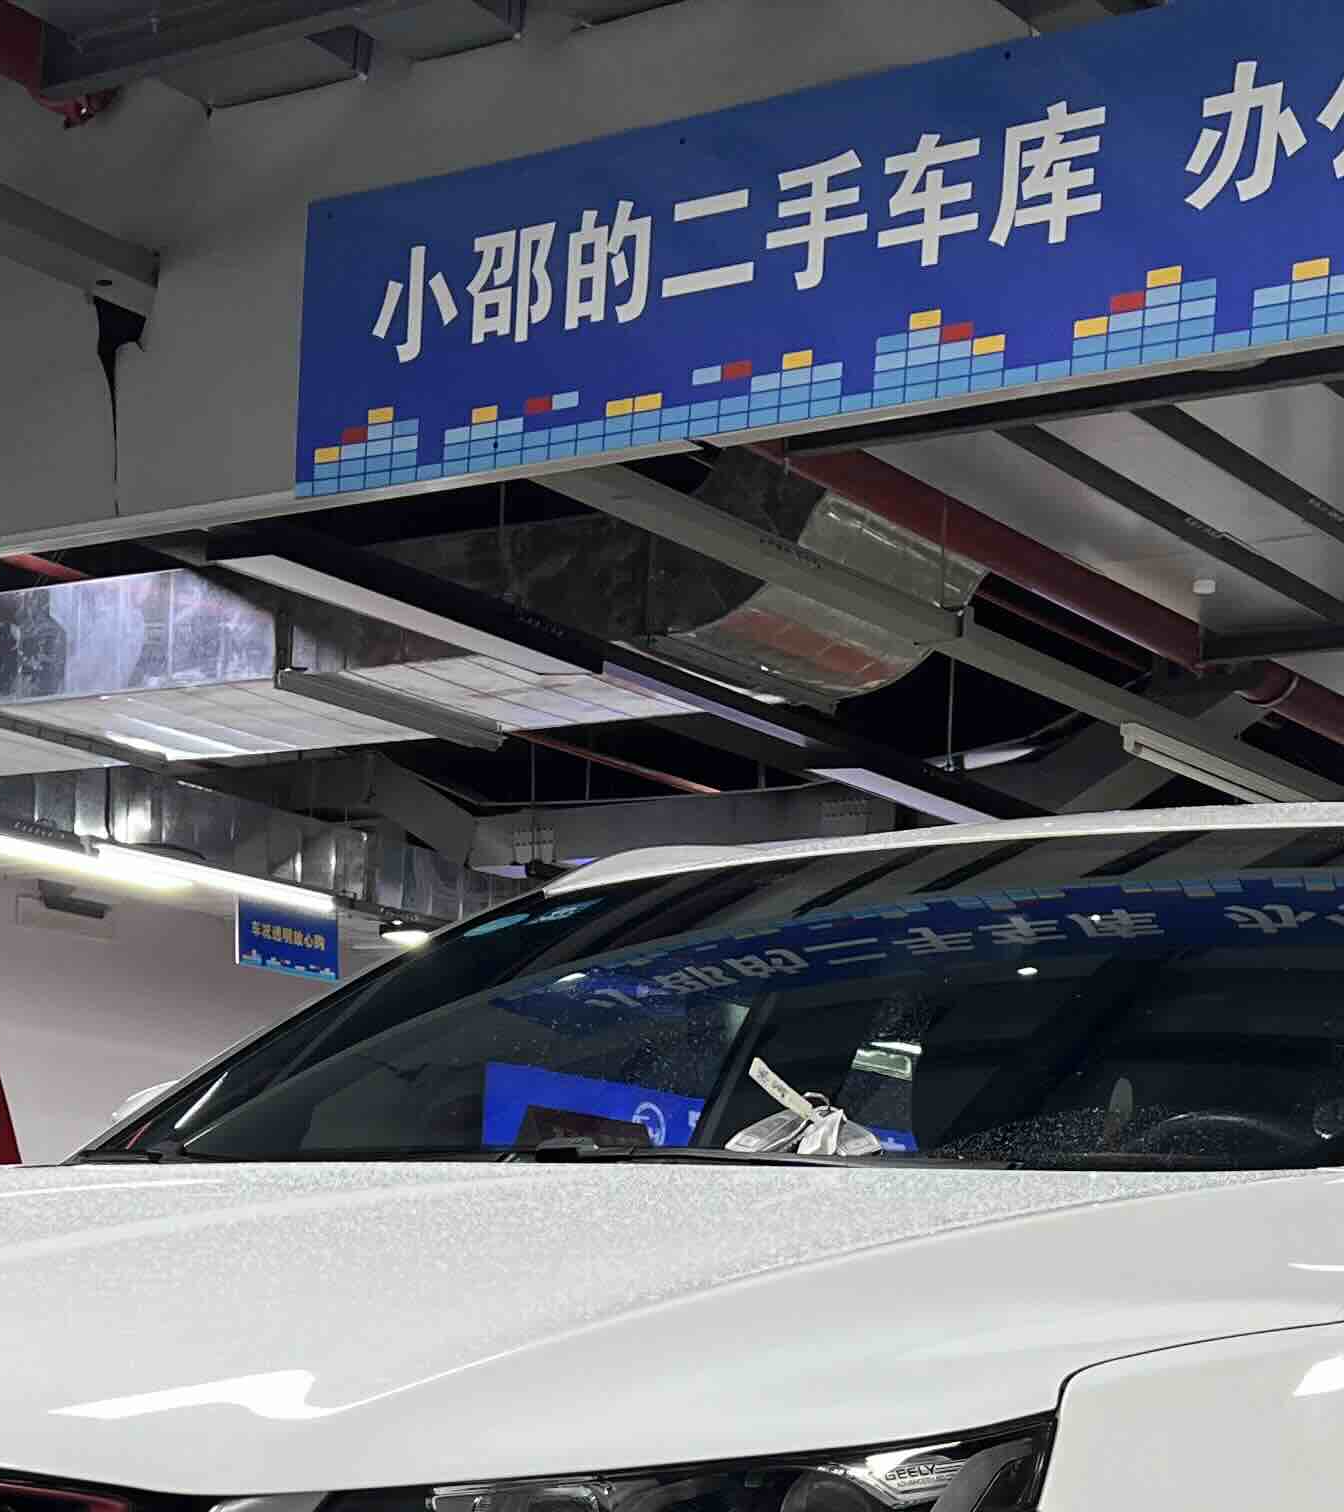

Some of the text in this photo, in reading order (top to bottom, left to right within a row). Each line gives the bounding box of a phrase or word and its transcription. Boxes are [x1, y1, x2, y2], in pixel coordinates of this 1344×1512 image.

[372, 100, 1107, 364] 小邵的二手车库
[885, 1463, 937, 1481] GEELY
